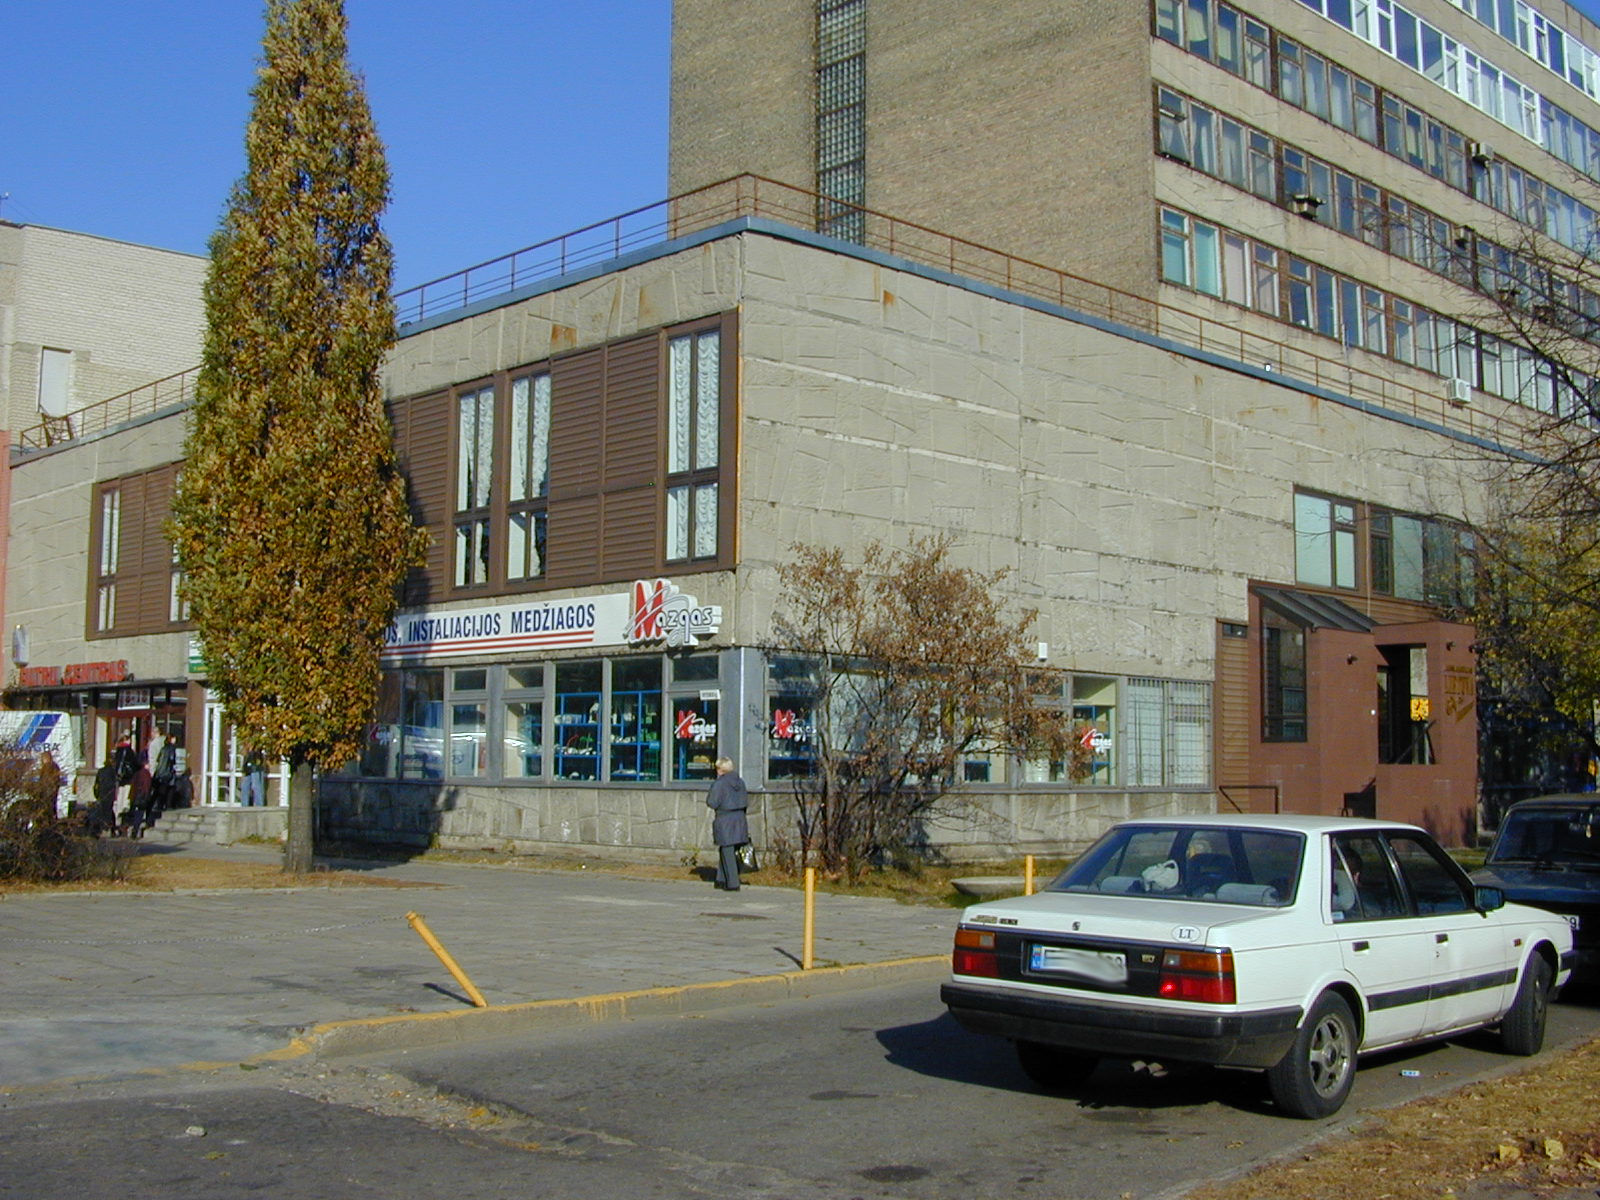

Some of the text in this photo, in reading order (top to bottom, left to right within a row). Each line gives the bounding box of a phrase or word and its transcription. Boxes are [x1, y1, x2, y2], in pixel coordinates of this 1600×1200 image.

[408, 612, 501, 641] INSTALIACIJOS
[510, 603, 595, 634] MEDŽIAGOS
[623, 580, 714, 646] Mazgas
[1178, 928, 1195, 939] LT
